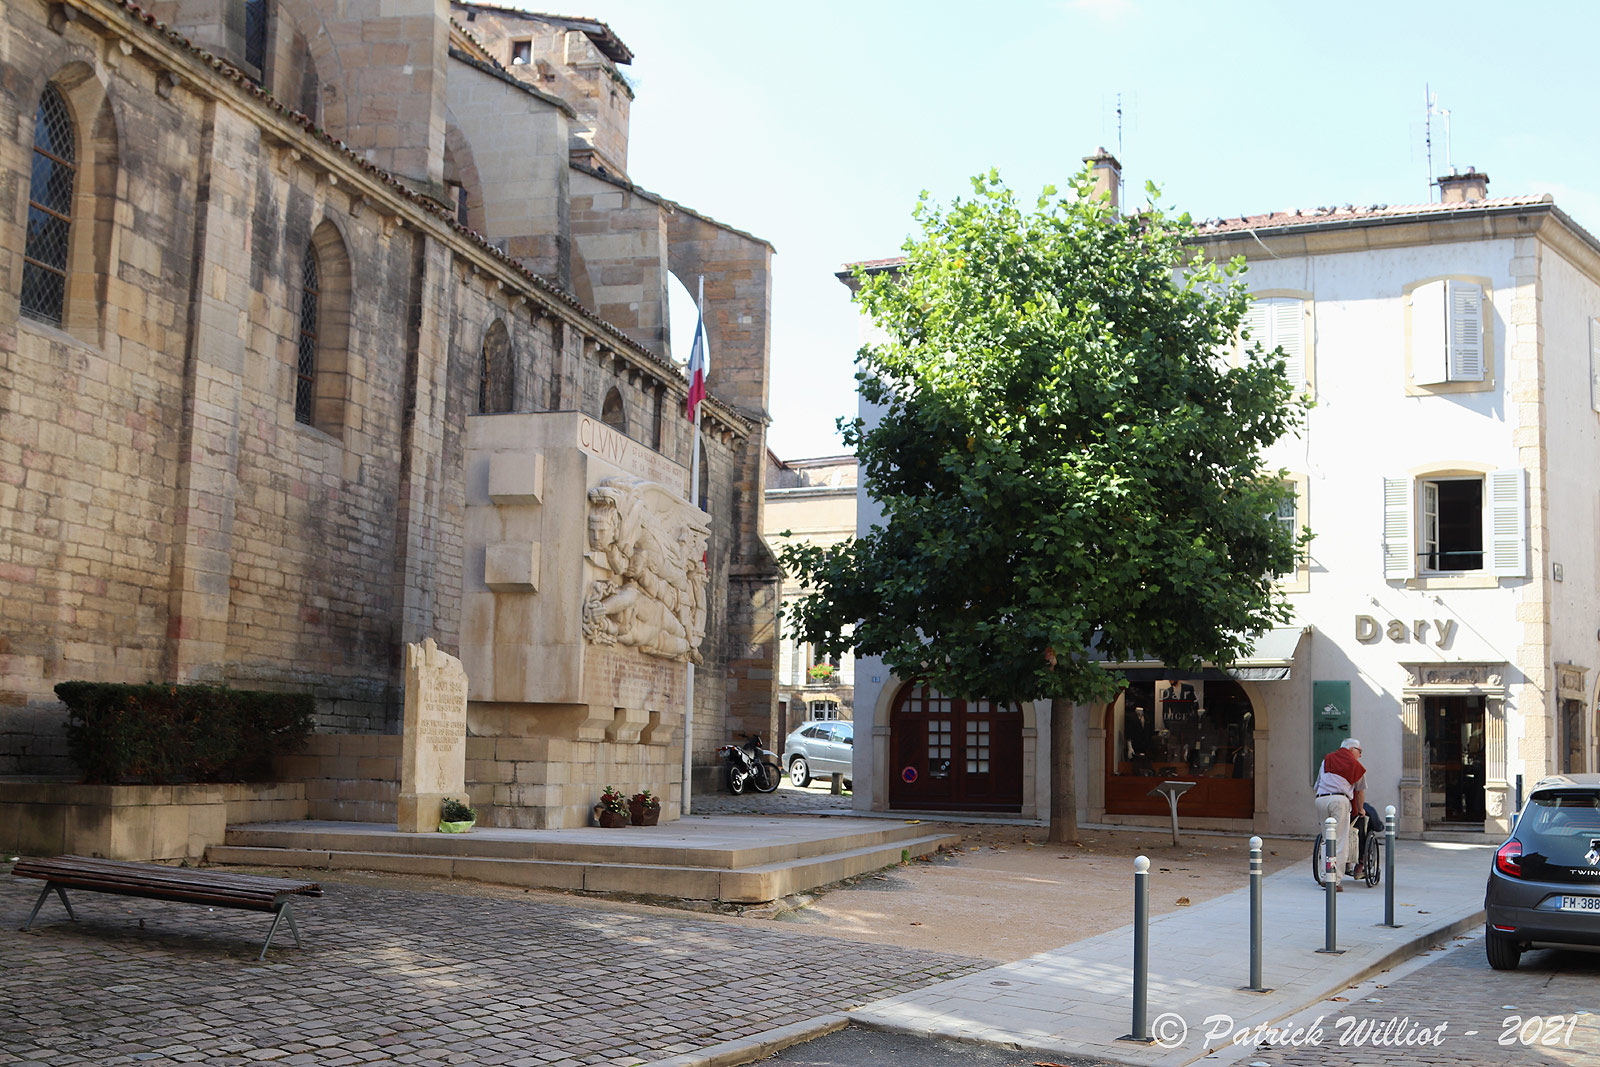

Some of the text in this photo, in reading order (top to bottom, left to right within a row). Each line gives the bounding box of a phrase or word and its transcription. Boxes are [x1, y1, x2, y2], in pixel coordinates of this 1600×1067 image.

[581, 418, 629, 464] CLVNY
[1355, 614, 1455, 648] Dary
[1159, 688, 1200, 703] Dary
